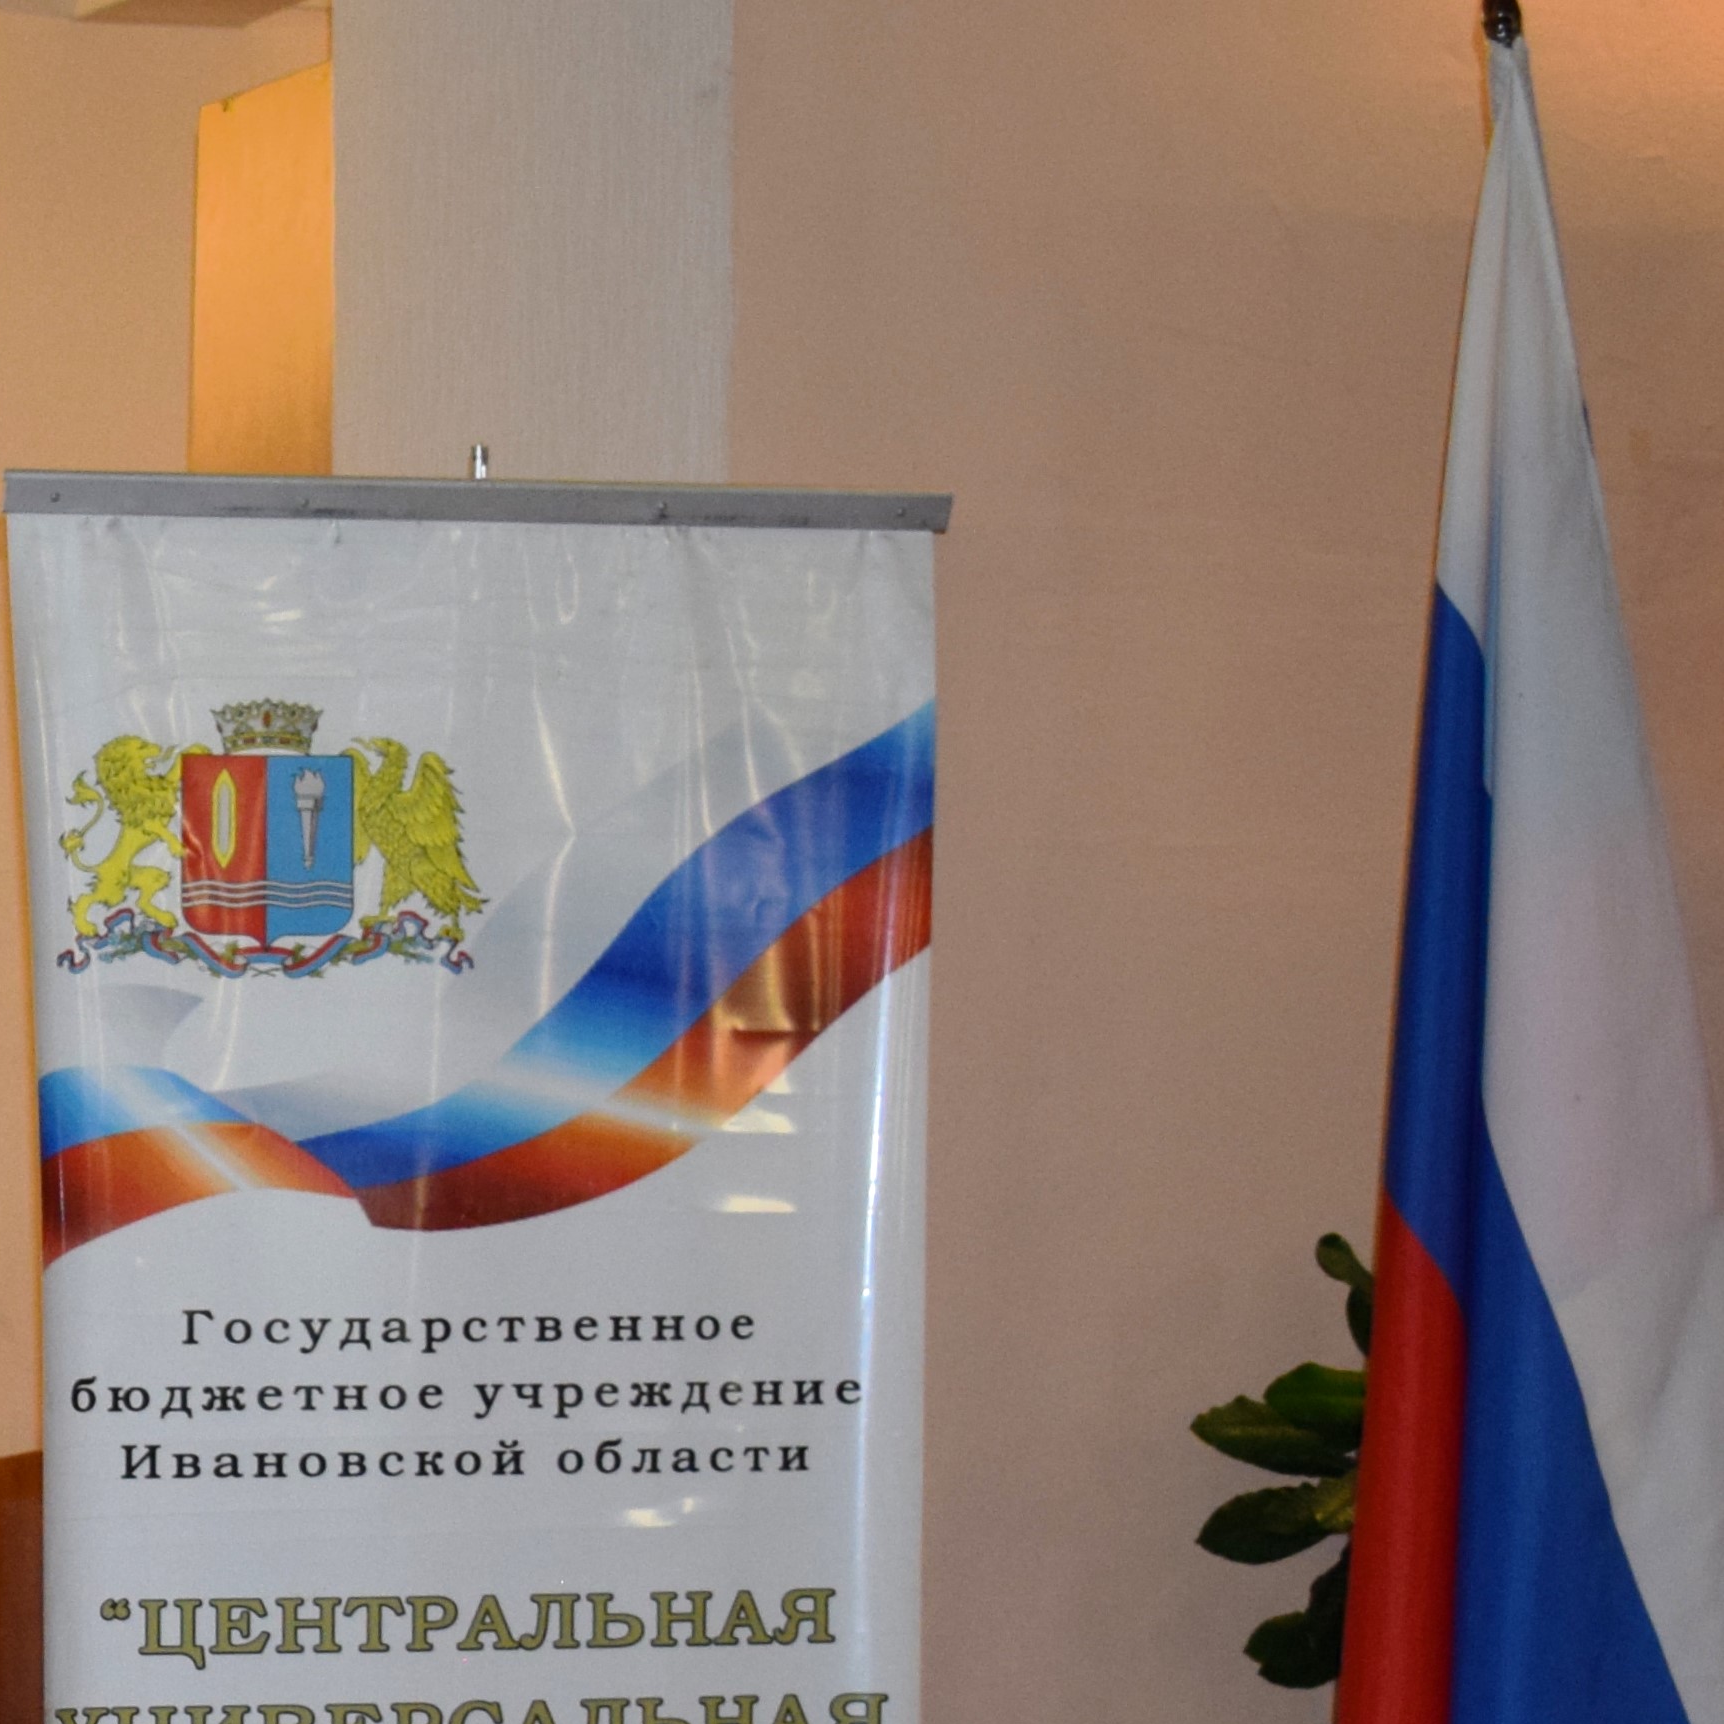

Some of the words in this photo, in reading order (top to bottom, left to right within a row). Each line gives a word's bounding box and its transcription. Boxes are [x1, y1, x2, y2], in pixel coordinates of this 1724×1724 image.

[182, 1310, 755, 1354] Государственное
[70, 1376, 444, 1419] бюджетное
[473, 1374, 863, 1420] учреждение
[121, 1439, 525, 1479] Ивановской
[557, 1438, 809, 1475] области
